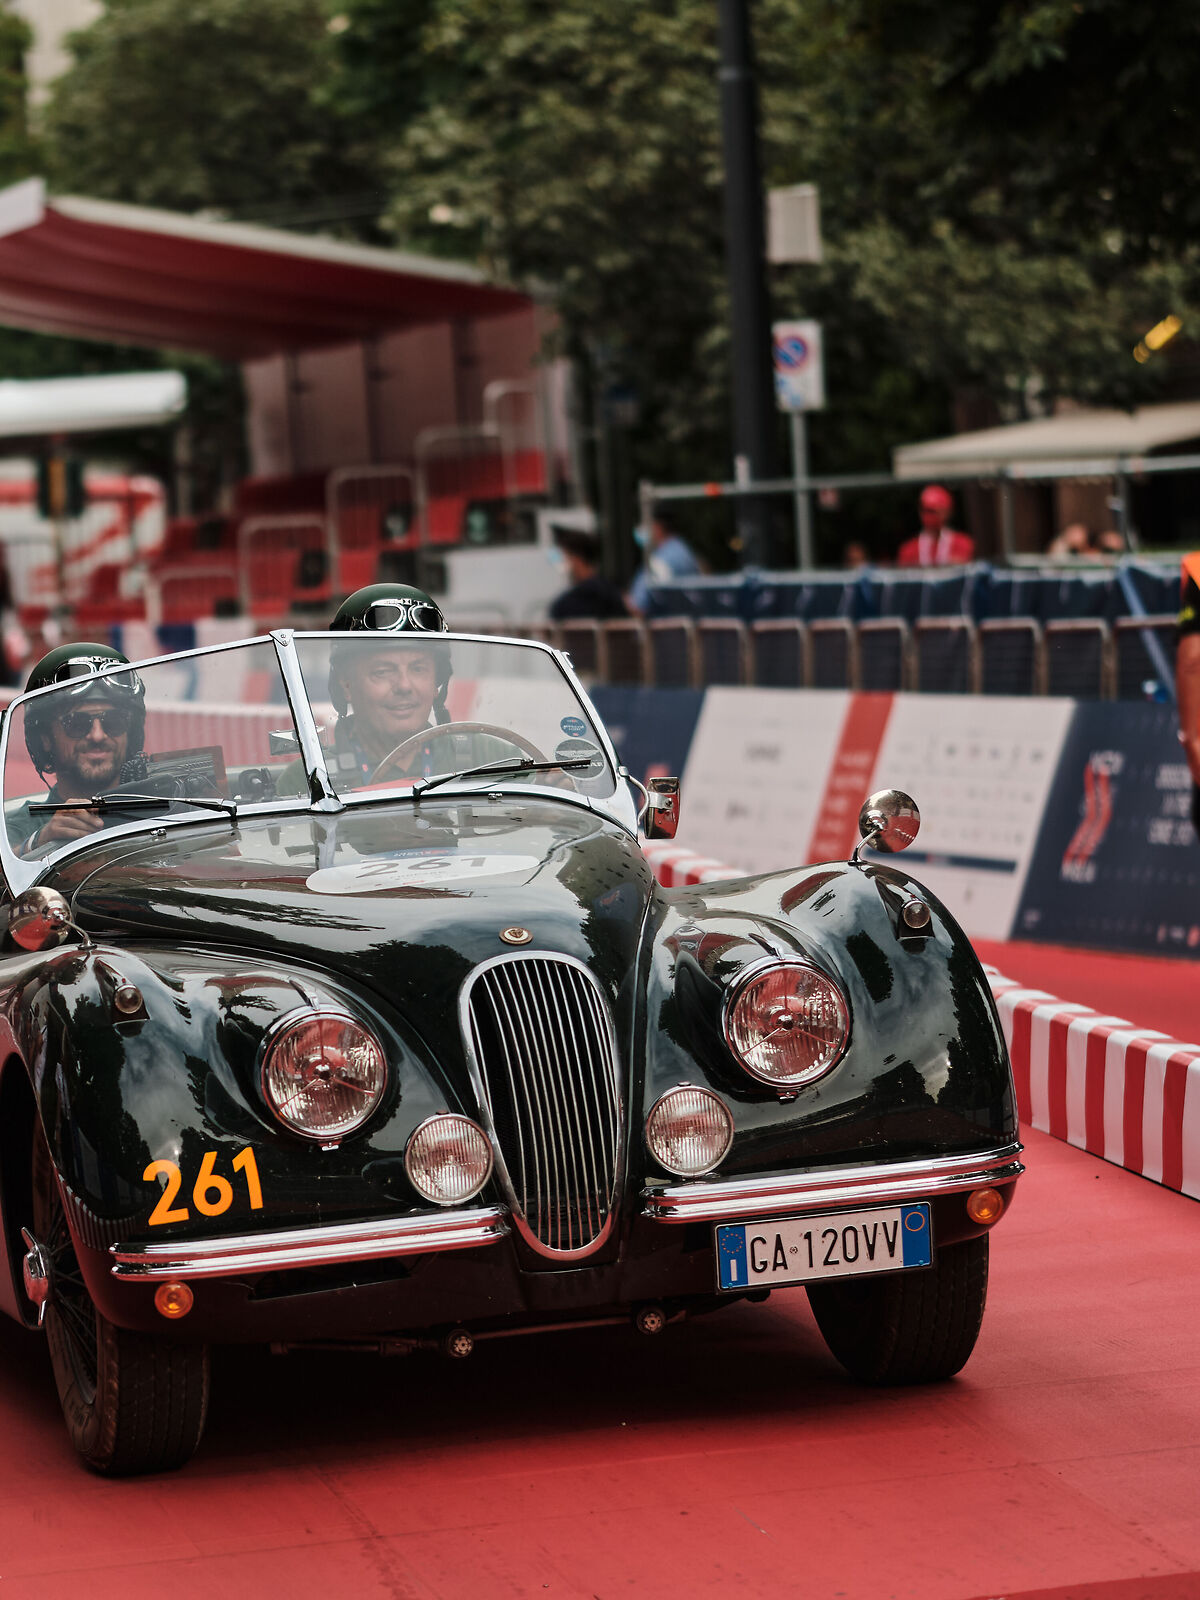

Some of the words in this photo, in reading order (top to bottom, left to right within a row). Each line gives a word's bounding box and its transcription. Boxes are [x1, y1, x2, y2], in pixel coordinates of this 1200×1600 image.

[355, 856, 487, 879] 261
[142, 1146, 264, 1226] 261
[750, 1233, 788, 1273] GA
[803, 1220, 899, 1268] 120VV
